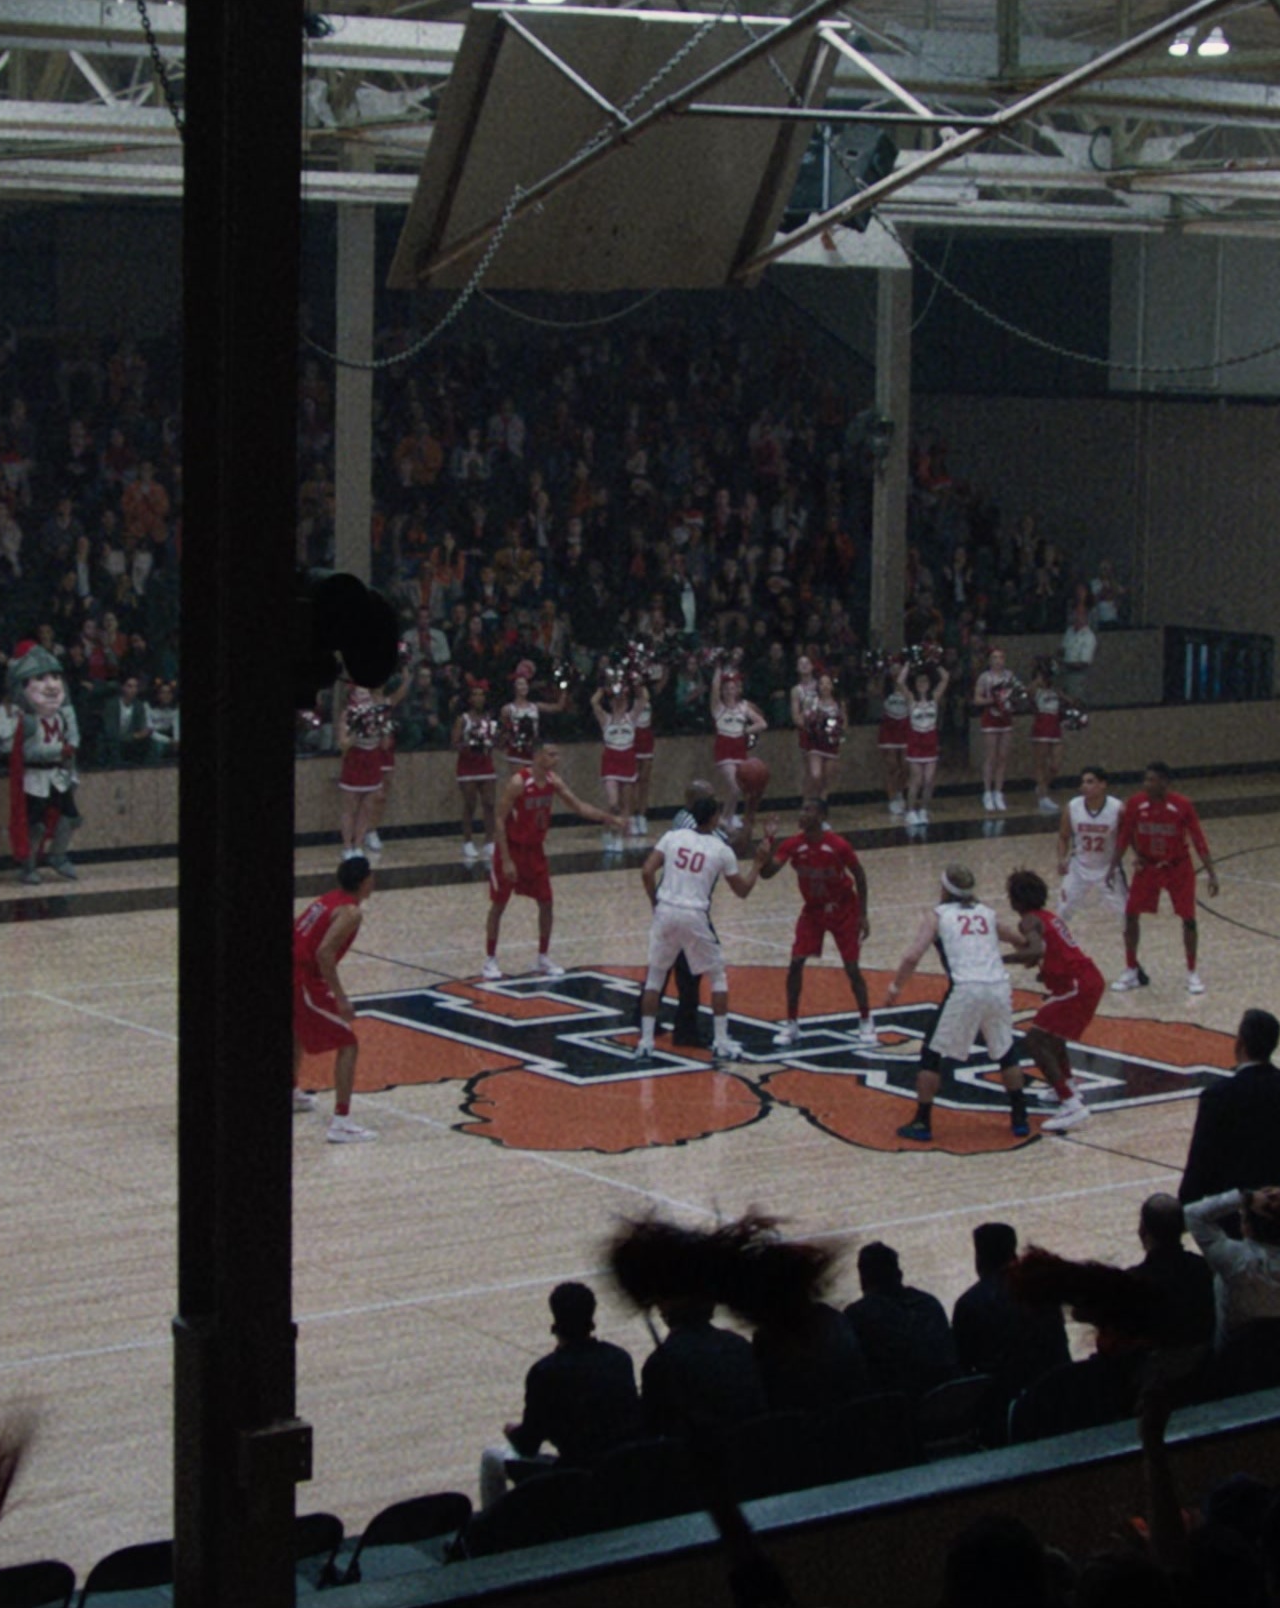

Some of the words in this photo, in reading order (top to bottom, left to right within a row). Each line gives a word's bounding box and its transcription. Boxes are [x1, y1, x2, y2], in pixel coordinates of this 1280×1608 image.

[40, 716, 64, 743] M
[1082, 835, 1105, 853] 32
[674, 847, 706, 873] 50
[957, 915, 989, 935] 23
